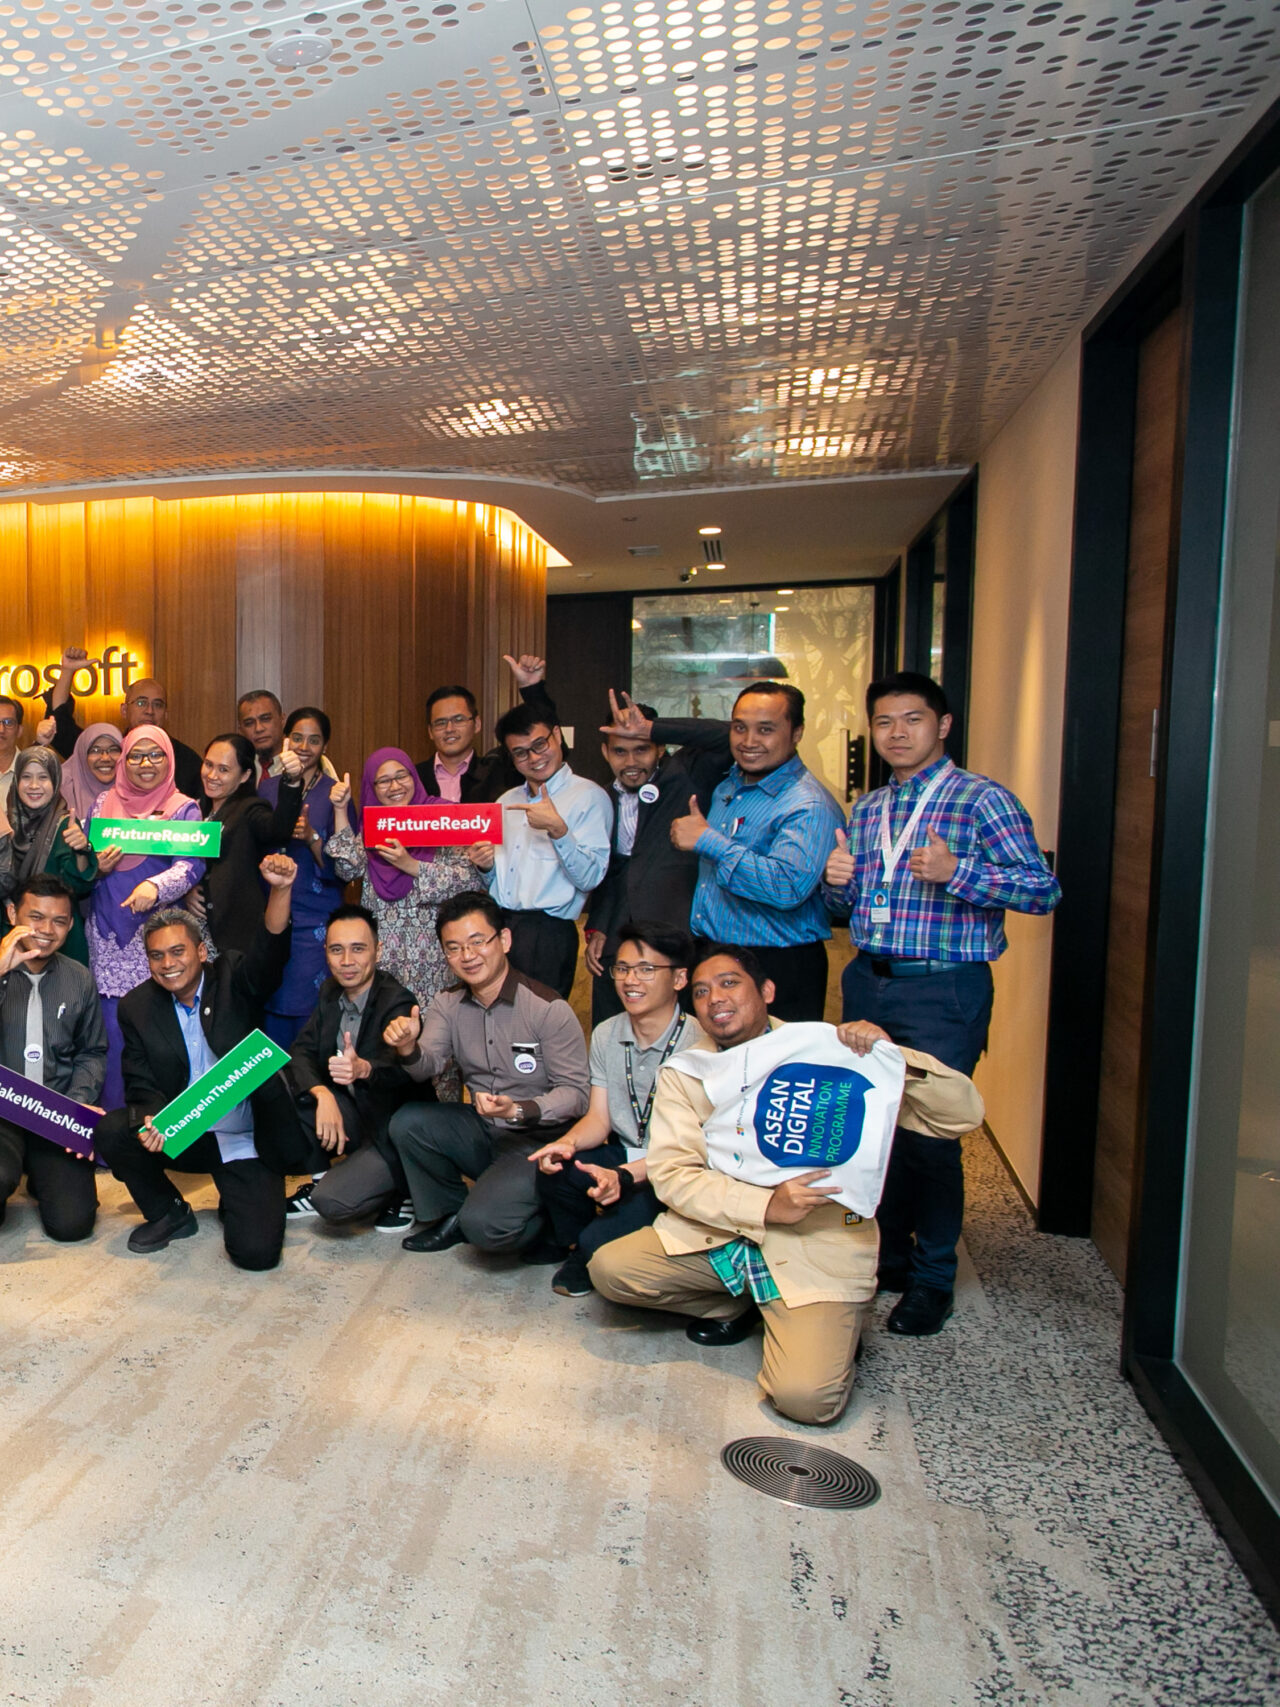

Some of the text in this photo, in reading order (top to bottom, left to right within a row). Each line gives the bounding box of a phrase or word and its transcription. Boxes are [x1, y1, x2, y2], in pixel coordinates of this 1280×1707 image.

[102, 827, 210, 846] #FutureReady
[377, 815, 491, 833] #FutureReady
[162, 1047, 274, 1141] ChangeInTheMaking
[763, 1078, 791, 1148] ASEAN
[783, 1078, 816, 1155] DIGITAL
[808, 1080, 834, 1158] INNOVATION
[825, 1081, 853, 1163] PROGRAMME
